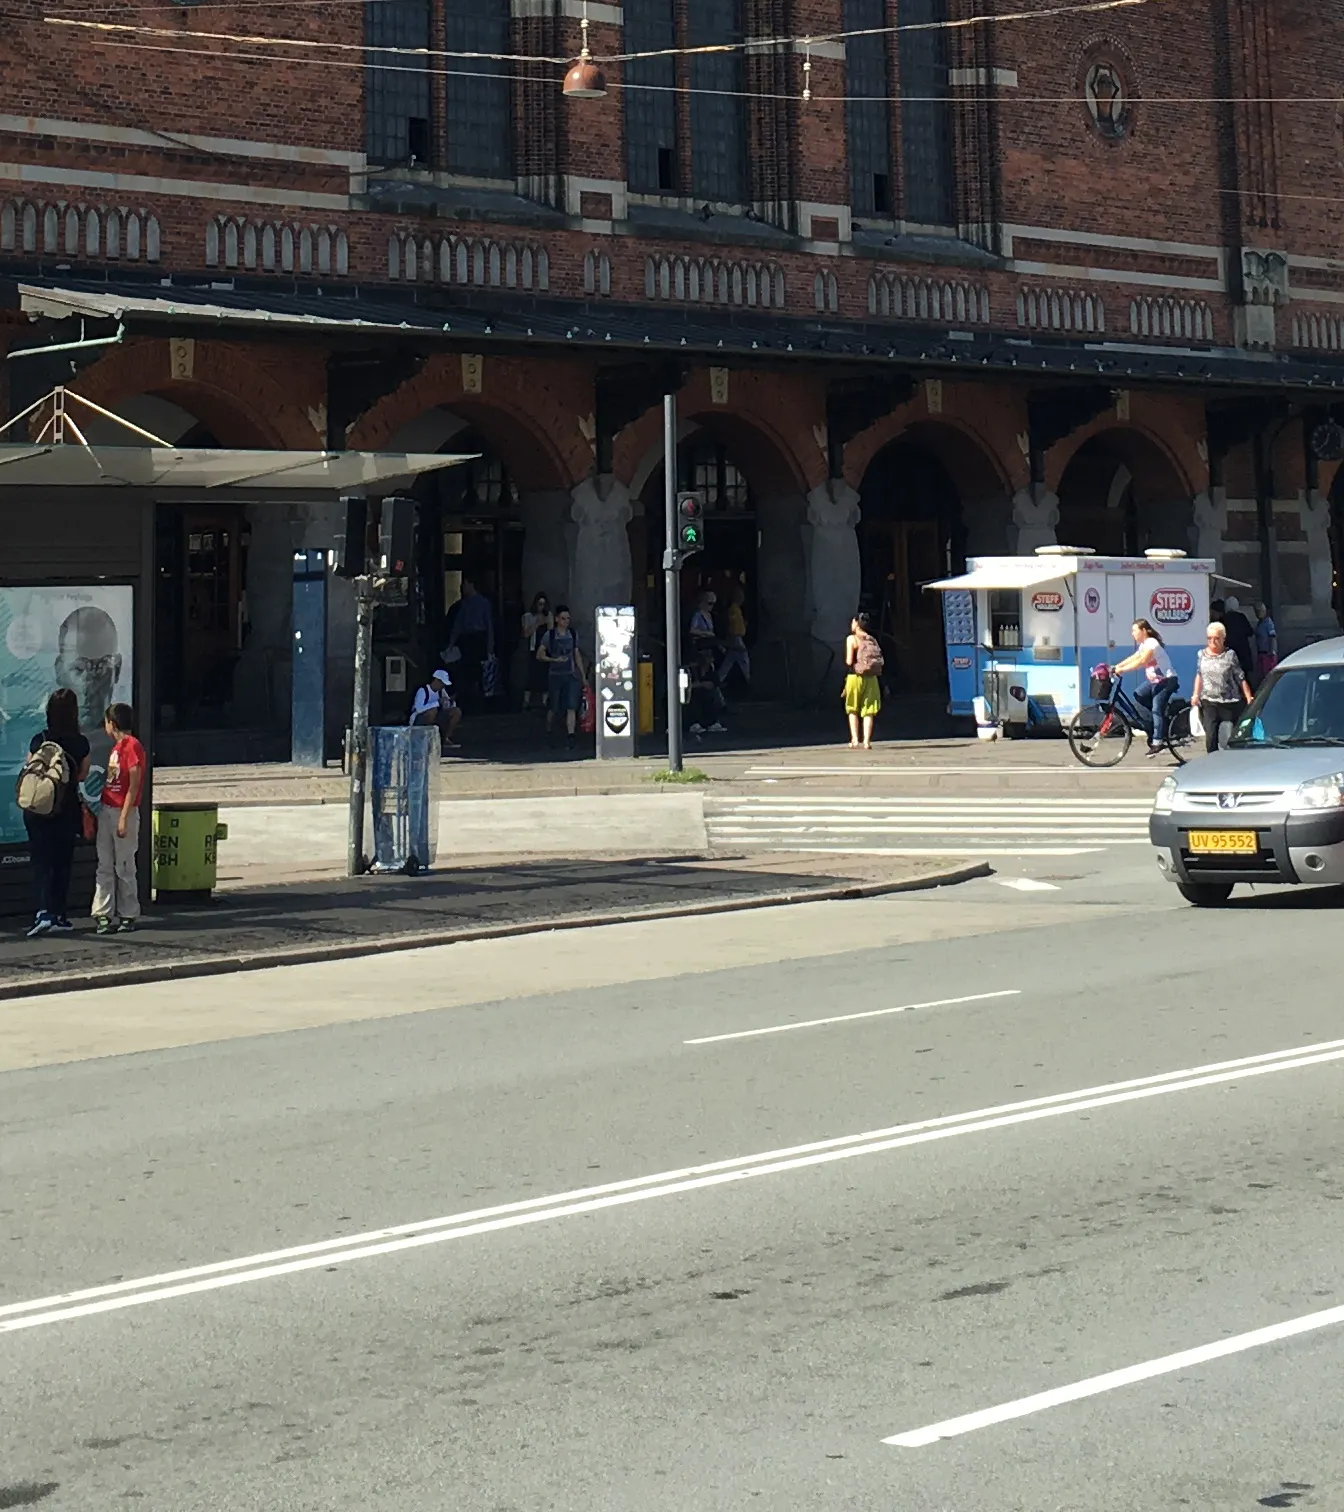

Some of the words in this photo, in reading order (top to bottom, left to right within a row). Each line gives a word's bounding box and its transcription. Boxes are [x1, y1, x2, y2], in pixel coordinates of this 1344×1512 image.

[1036, 595, 1060, 604] STEFF
[1156, 593, 1188, 610] STEFF
[1191, 835, 1208, 848] UV
